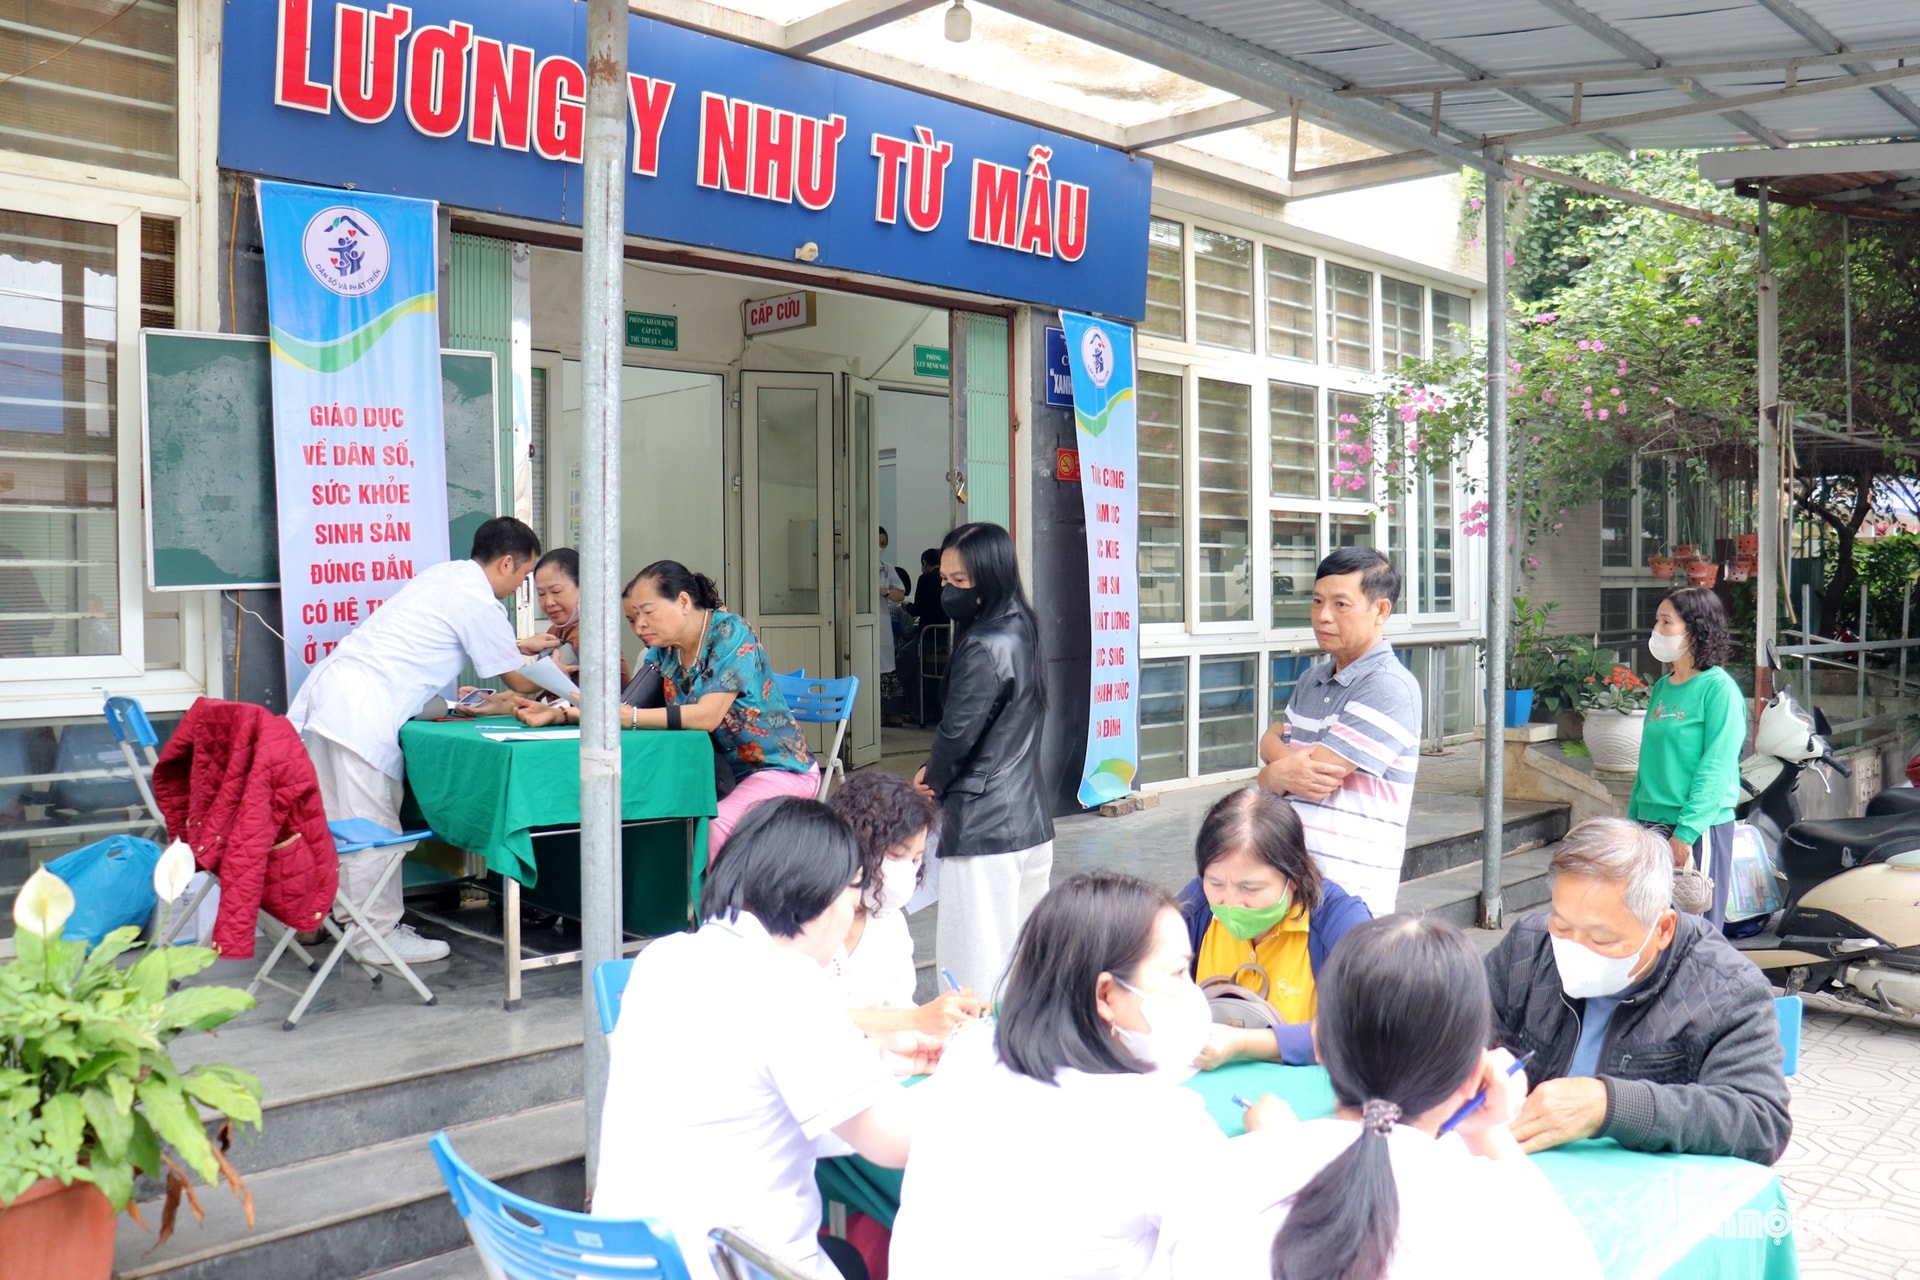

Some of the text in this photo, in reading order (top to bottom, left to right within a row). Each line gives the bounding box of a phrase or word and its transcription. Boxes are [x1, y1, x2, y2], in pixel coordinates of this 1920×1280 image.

[275, 0, 1089, 262] LƯƠNG Y NHƯ TỪ MẪU
[349, 281, 366, 291] PHÁT
[750, 296, 800, 326] CẤP CỨU
[310, 402, 404, 432] GIÁO DỤC
[303, 438, 415, 468] VỀ DÂN SỐ,
[312, 475, 411, 506] SỨC KHỎE
[315, 513, 412, 545] SINH SẢN
[310, 558, 366, 585] ĐÚNG
[302, 598, 328, 625] CÓ
[333, 596, 359, 626] HỆ
[304, 634, 318, 665] Ở
